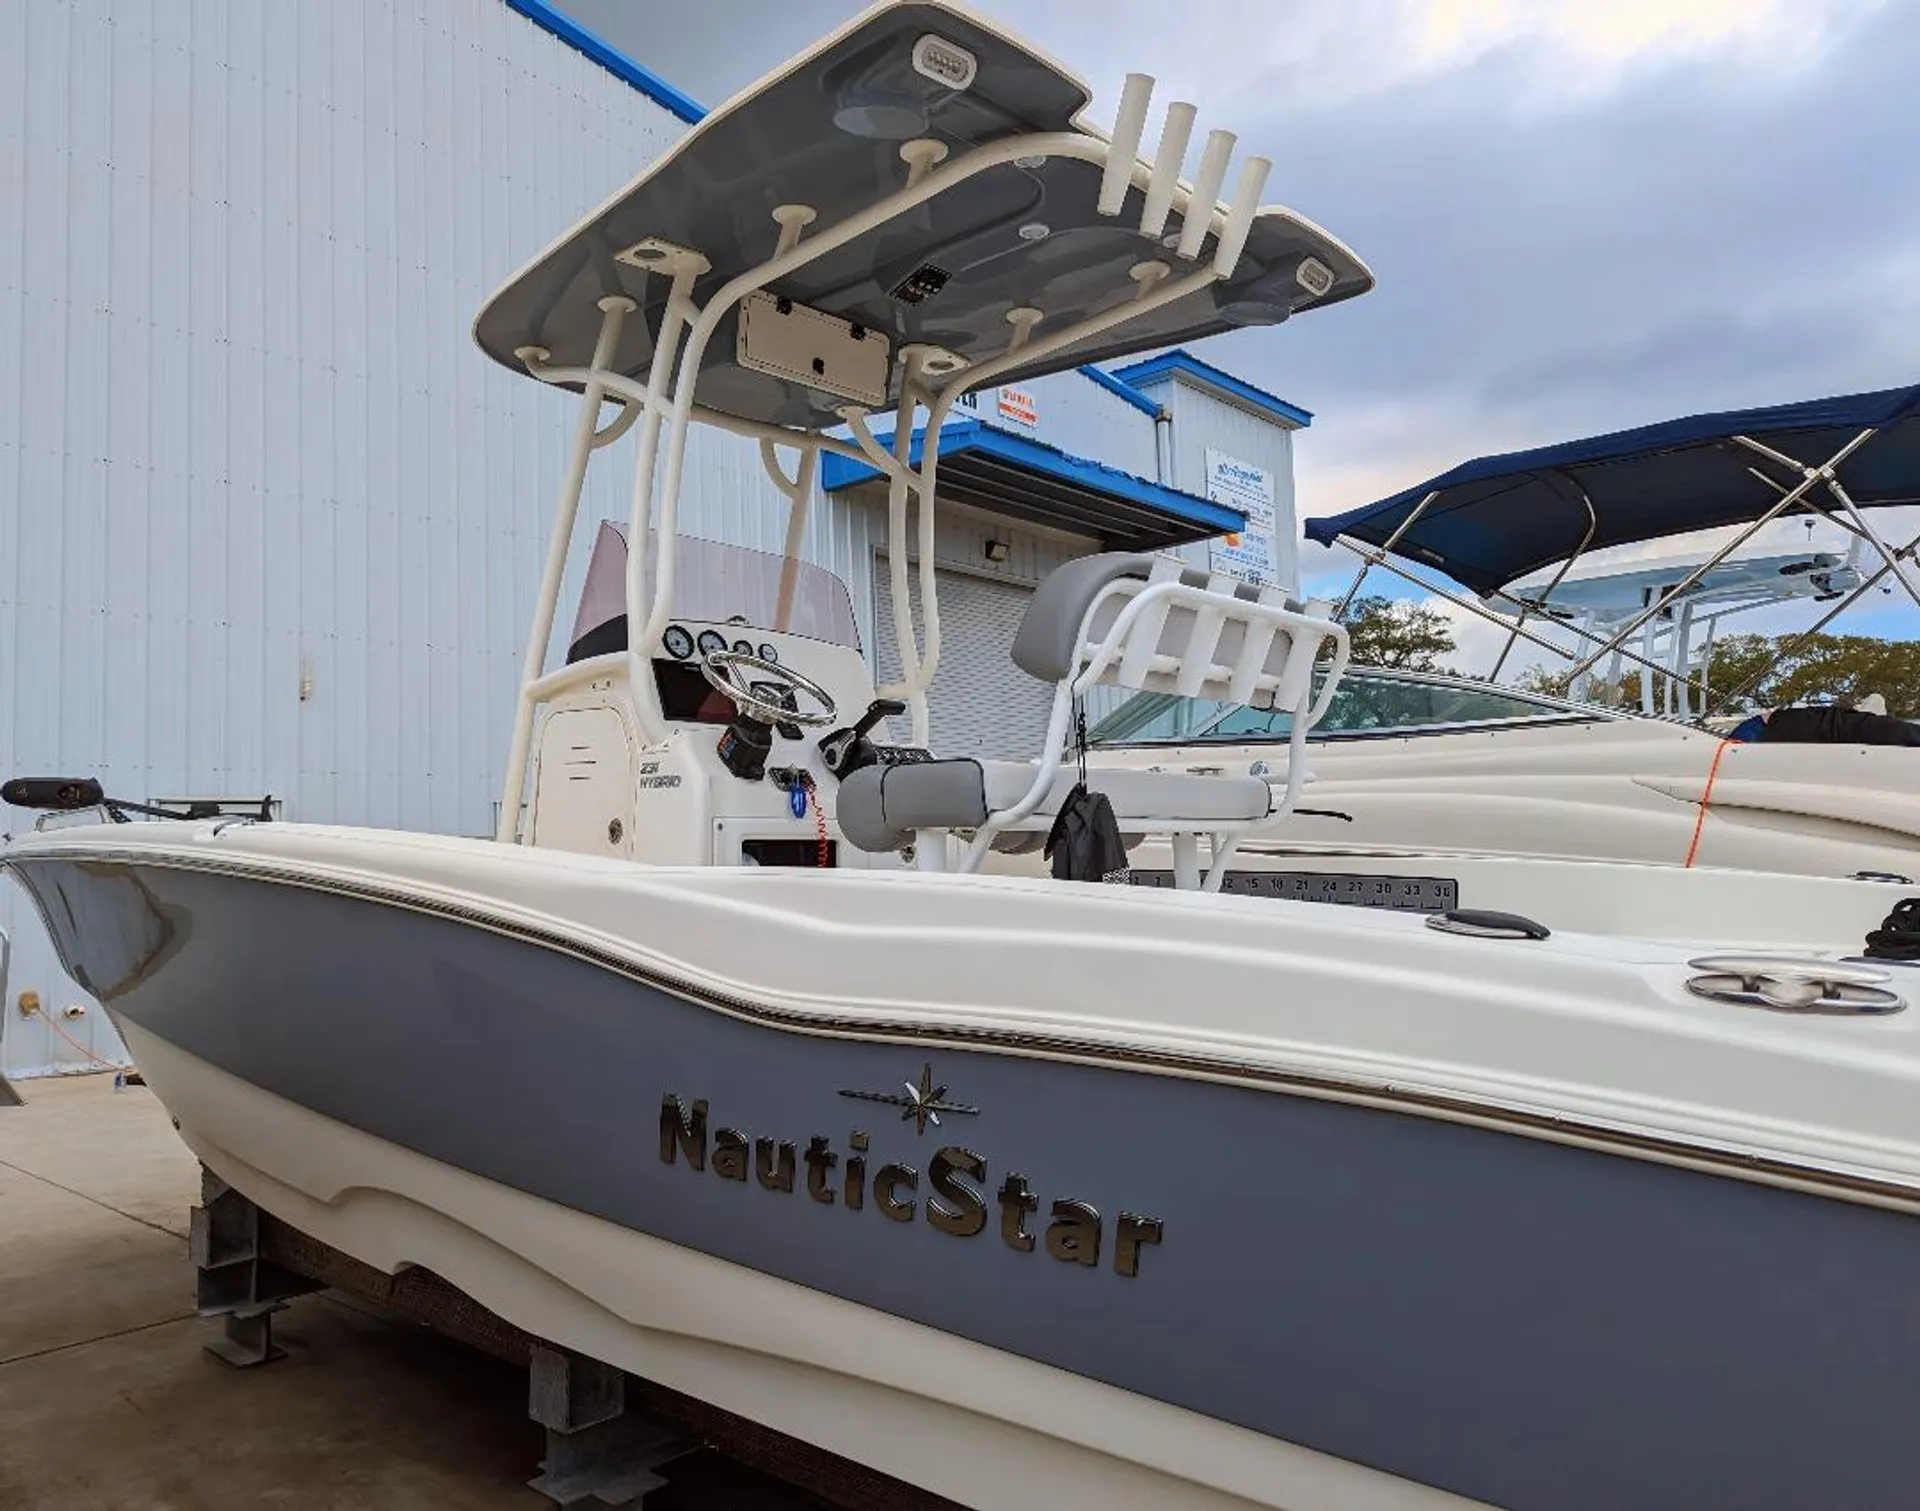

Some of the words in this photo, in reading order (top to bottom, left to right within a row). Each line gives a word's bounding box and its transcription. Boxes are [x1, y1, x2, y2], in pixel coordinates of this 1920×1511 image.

[640, 775, 682, 789] HYBRID
[1246, 878, 1259, 889] 15
[1271, 879, 1284, 890] 18
[1296, 880, 1309, 891] 21
[1322, 880, 1337, 892] 24
[1348, 881, 1363, 892] 27
[1375, 883, 1392, 894] 30
[1404, 884, 1420, 896] 33
[659, 1091, 1163, 1278] NauticStar
